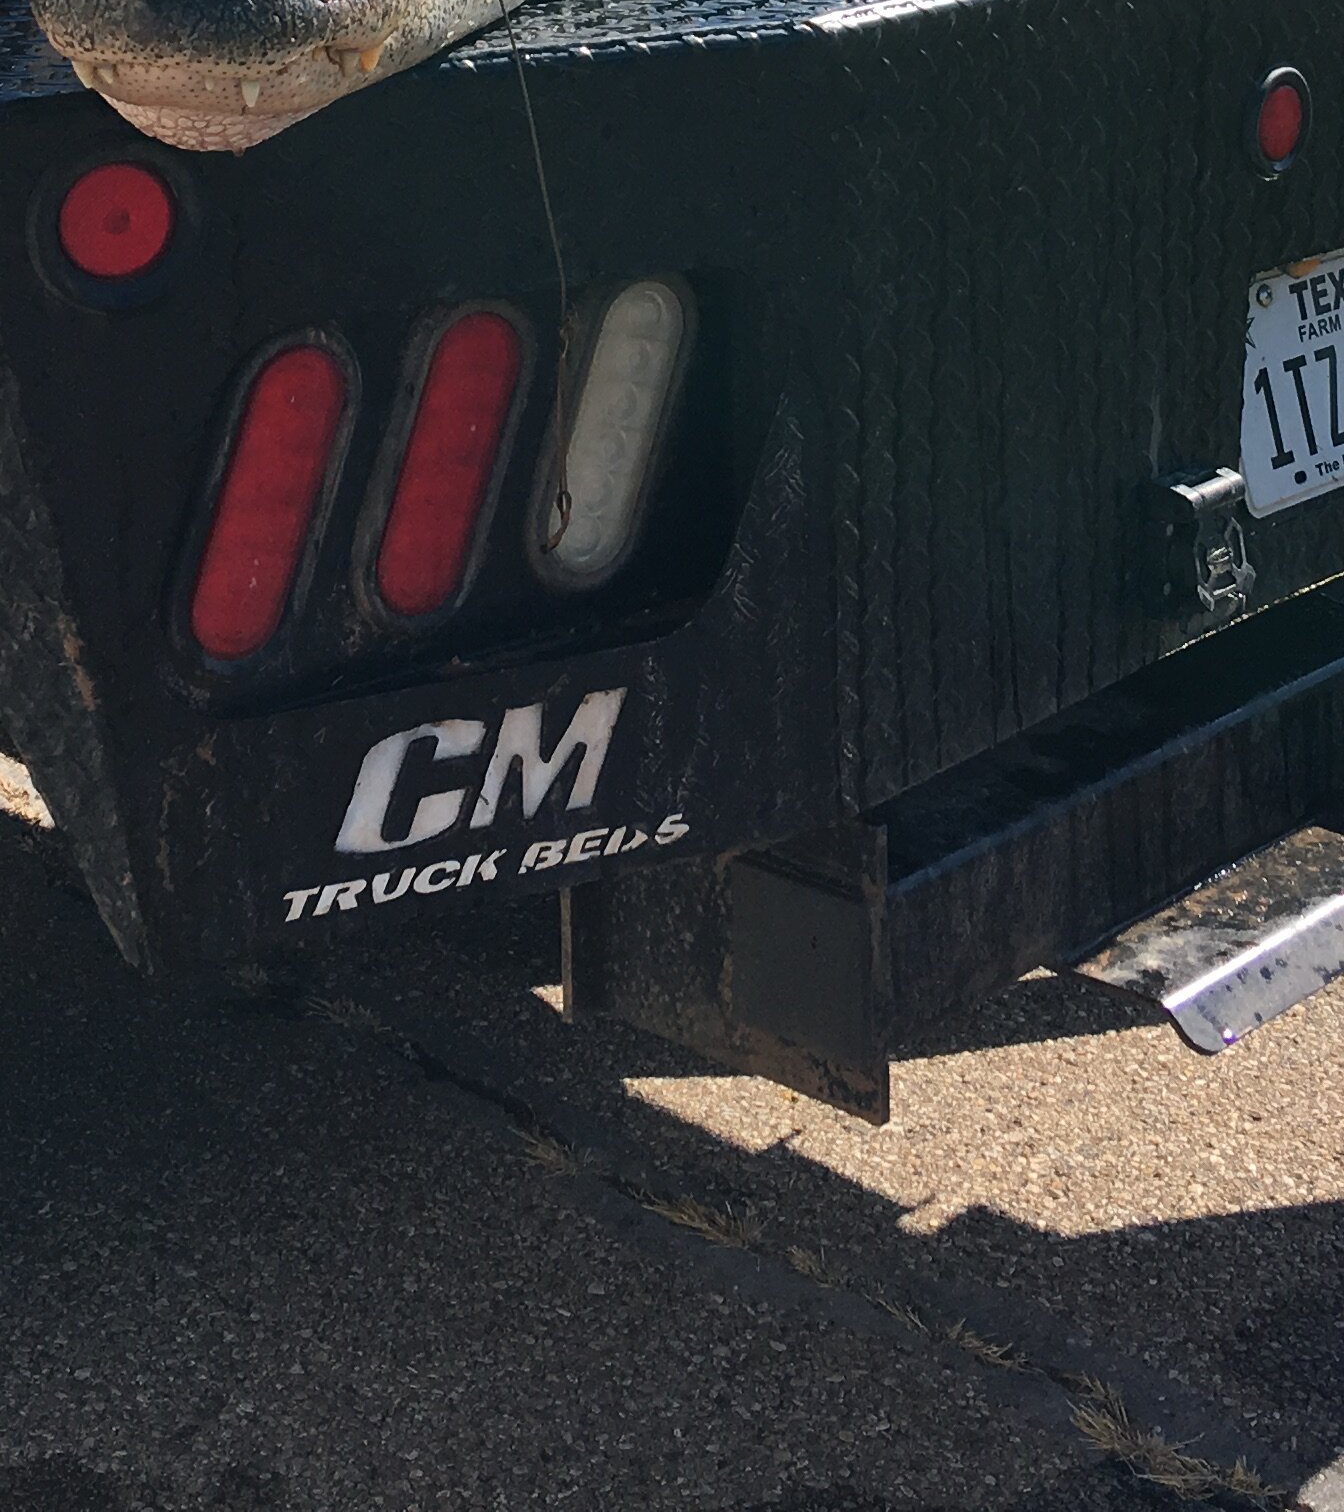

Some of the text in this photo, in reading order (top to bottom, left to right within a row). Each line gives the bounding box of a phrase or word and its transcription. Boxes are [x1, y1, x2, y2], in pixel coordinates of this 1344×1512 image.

[1298, 314, 1342, 343] FARM
[1315, 458, 1340, 477] The
[334, 687, 628, 855] CM
[283, 813, 690, 922] TRUCK BEDS
